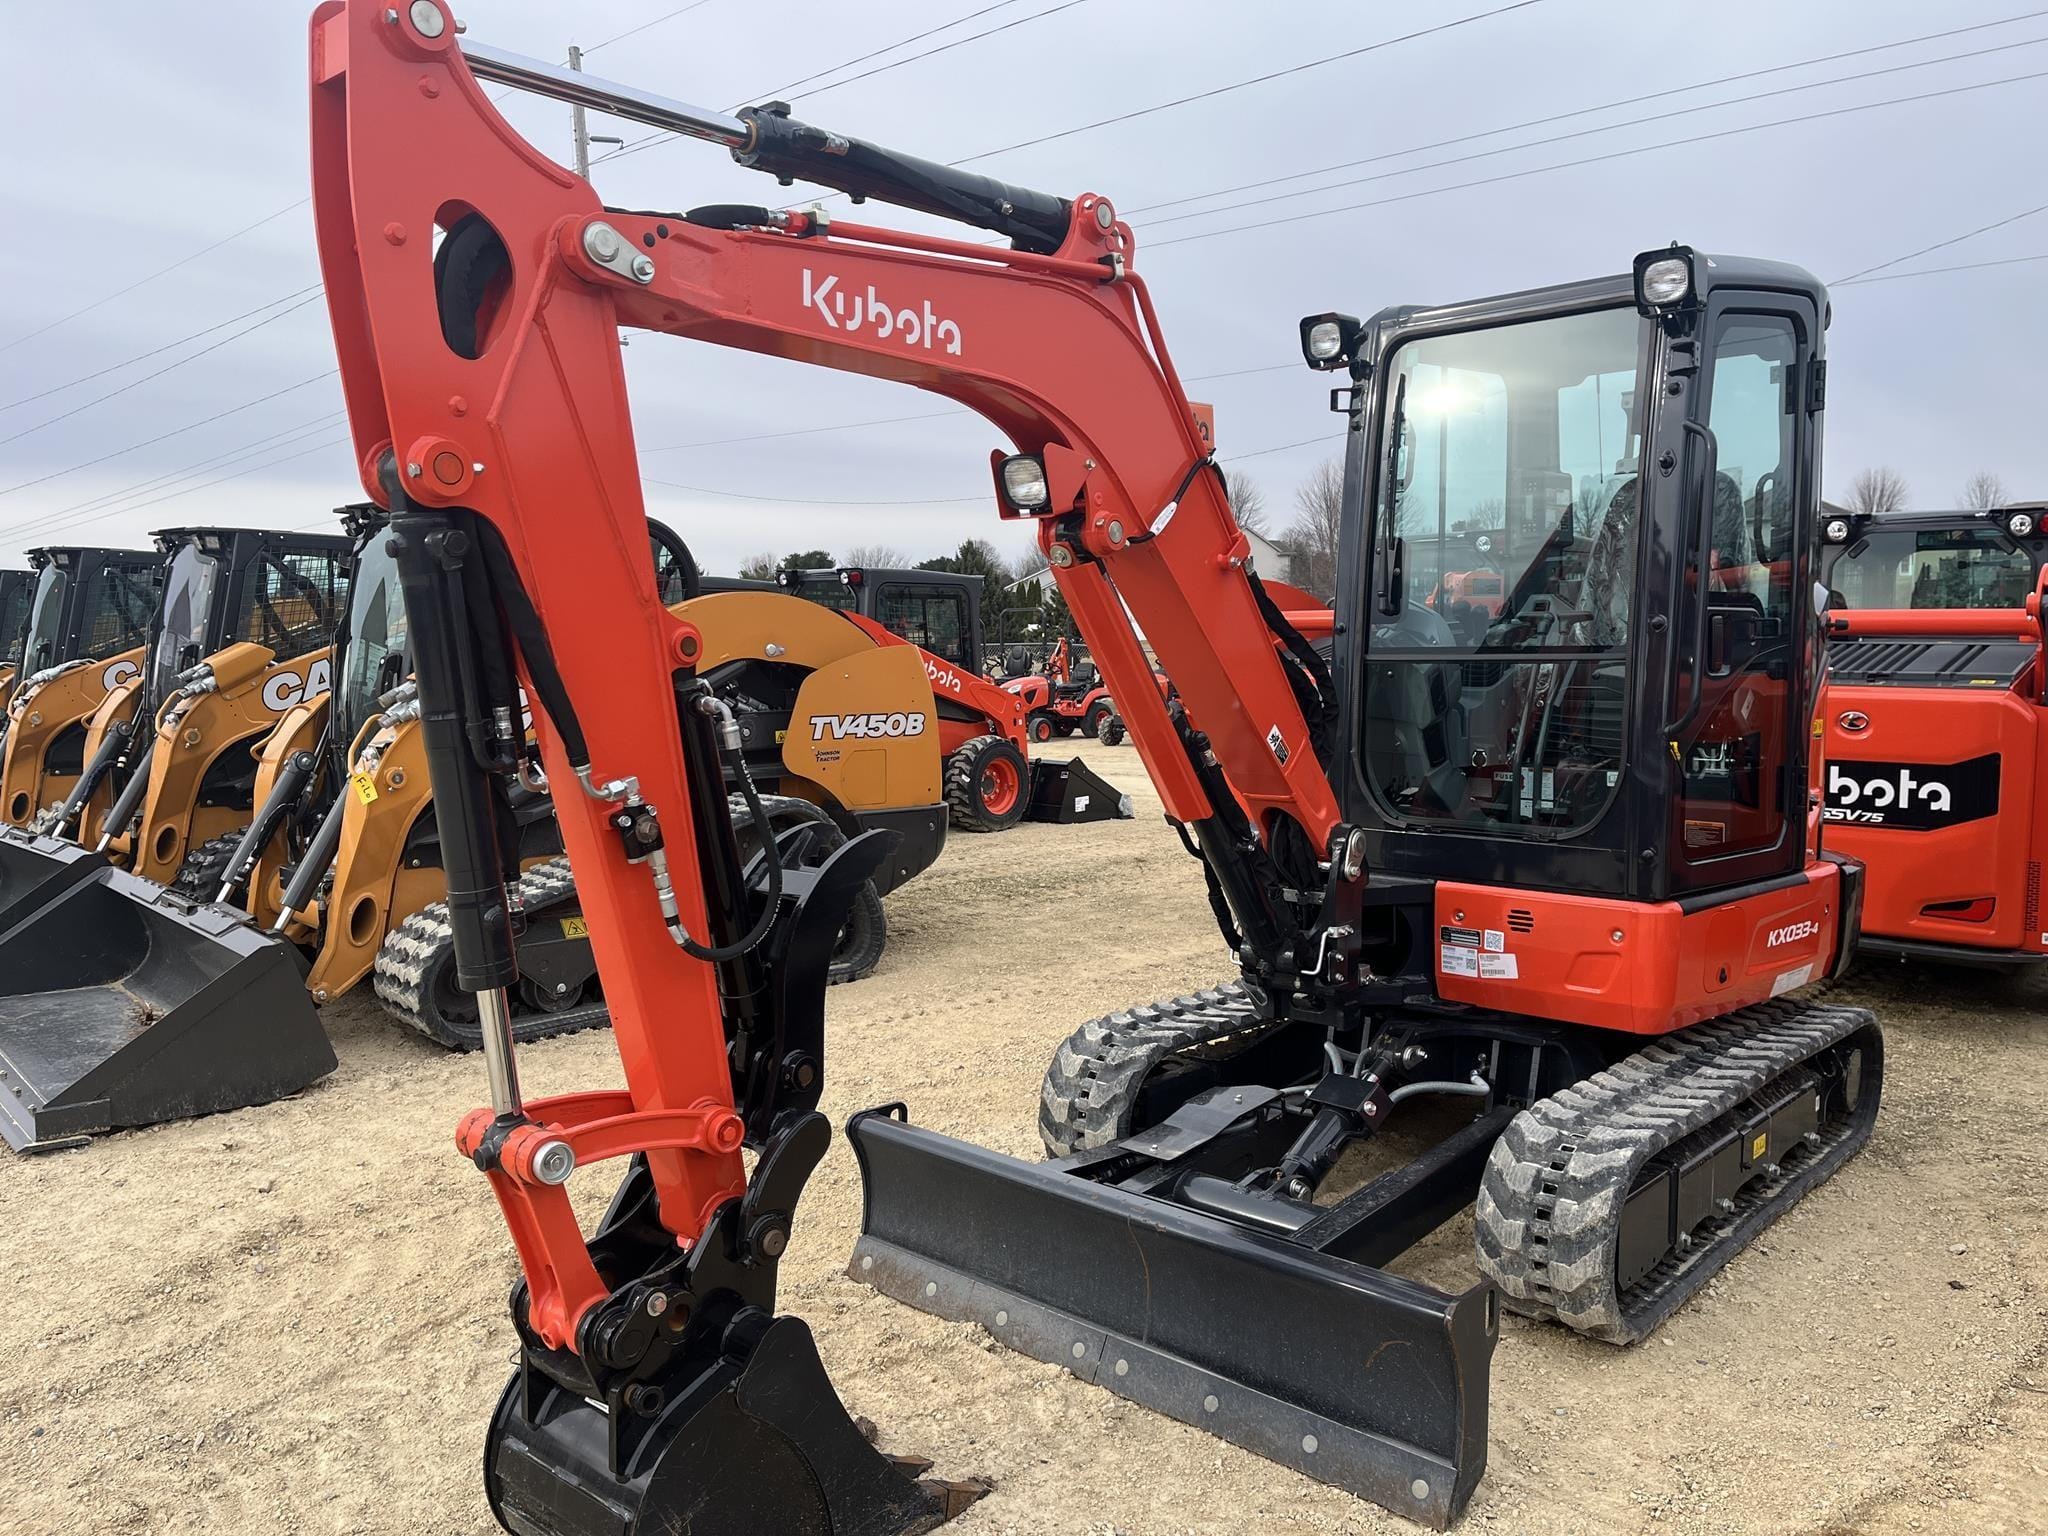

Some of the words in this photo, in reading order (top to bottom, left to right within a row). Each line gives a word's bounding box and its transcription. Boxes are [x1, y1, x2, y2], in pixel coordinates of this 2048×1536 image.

[803, 268, 962, 356] Kubota
[809, 712, 926, 740] TV450B
[1829, 765, 1951, 812] bota
[1767, 920, 1819, 948] KX033-4
